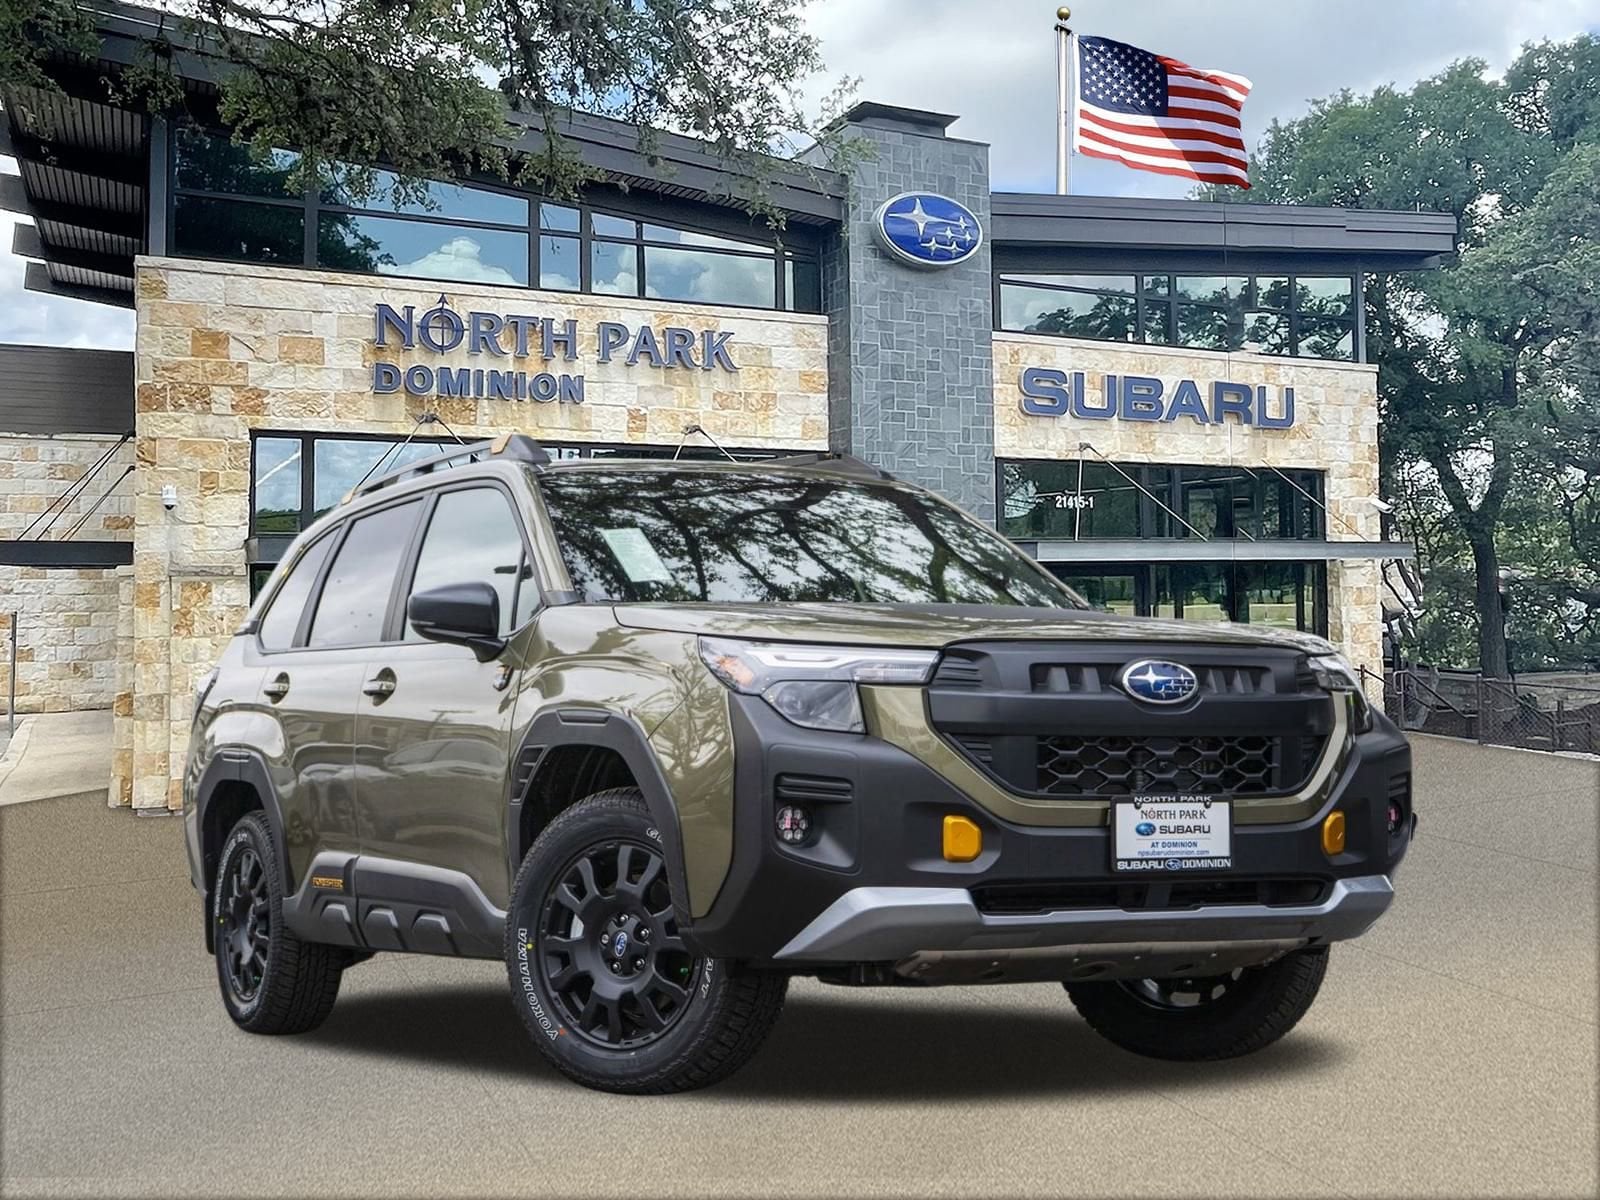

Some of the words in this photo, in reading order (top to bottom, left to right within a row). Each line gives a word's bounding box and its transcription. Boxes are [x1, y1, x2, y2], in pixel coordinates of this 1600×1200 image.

[374, 295, 579, 362] NORTH
[597, 321, 741, 373] PARK
[373, 362, 585, 405] DOMINION
[1019, 367, 1295, 430] SUBARU
[1140, 808, 1176, 820] NORTH
[1179, 810, 1207, 820] PARK
[1159, 825, 1211, 835] SUBARU
[1161, 841, 1198, 849] DOMINION
[1117, 860, 1164, 870] SUBARU
[1182, 859, 1231, 868] DOMINION
[518, 928, 559, 1040] YOKOHAMA
